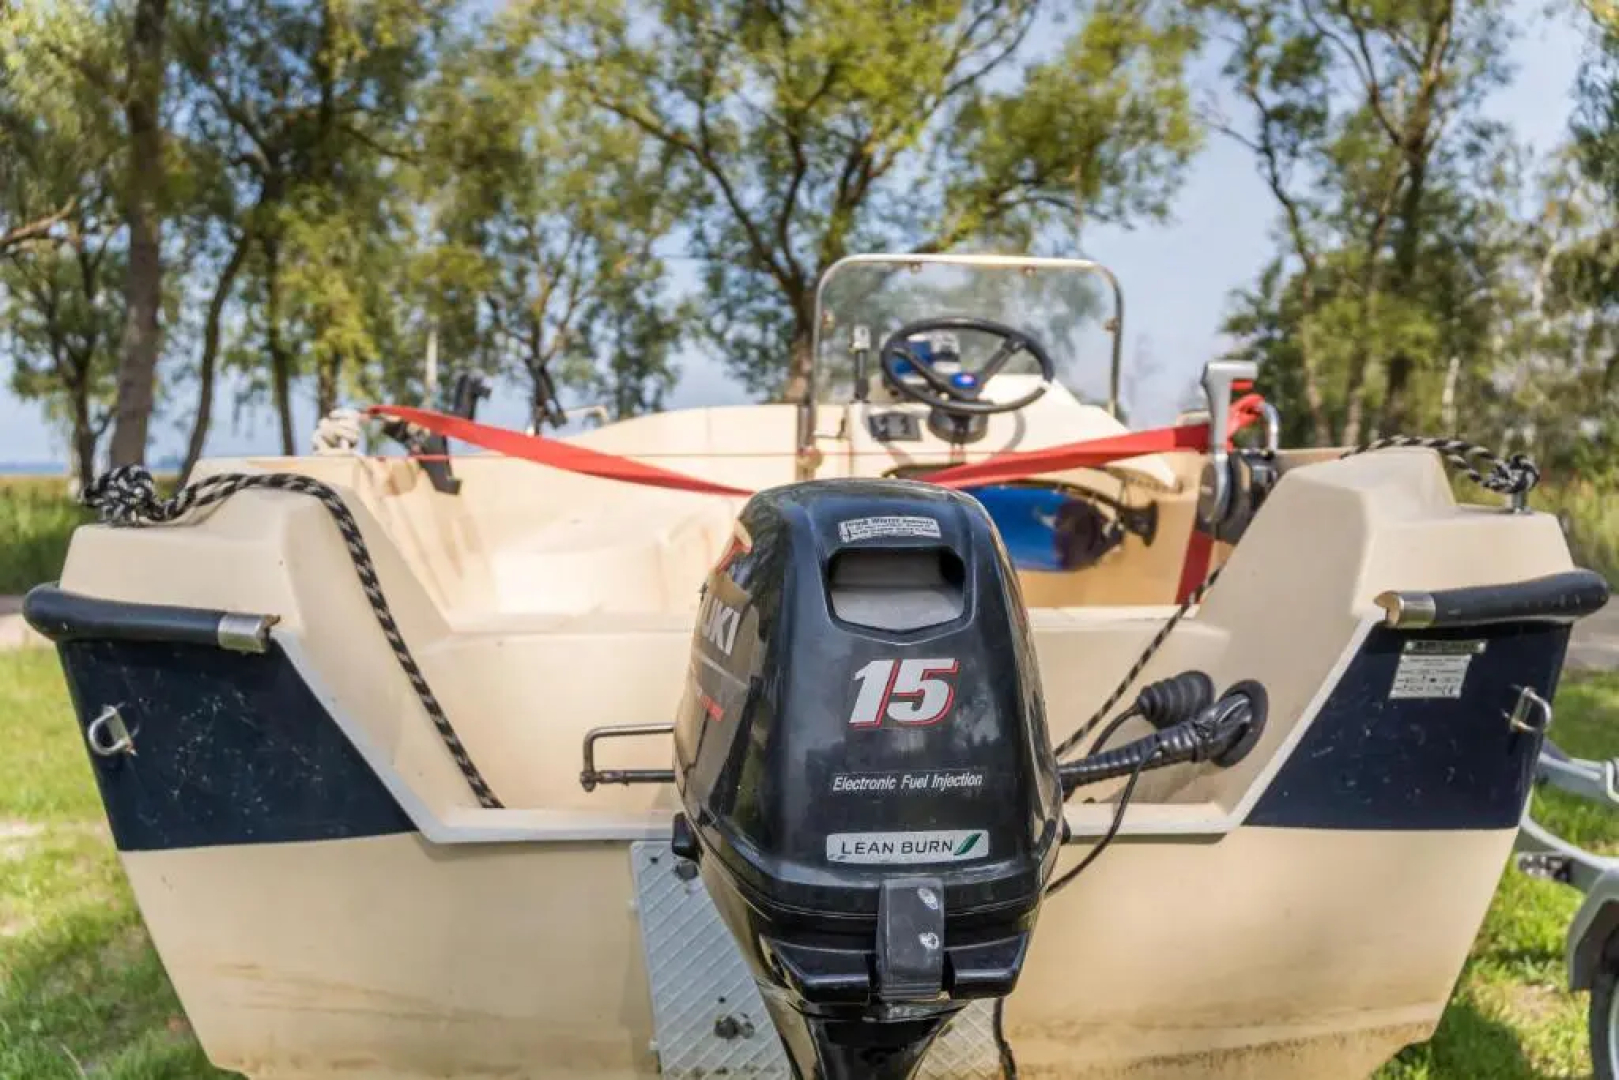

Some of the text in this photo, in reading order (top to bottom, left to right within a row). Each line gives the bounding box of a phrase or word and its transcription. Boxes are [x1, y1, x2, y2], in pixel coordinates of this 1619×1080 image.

[849, 657, 960, 729] 15
[832, 771, 983, 792] Electronic Fuel Injection
[840, 839, 954, 855] LEAN BURN
